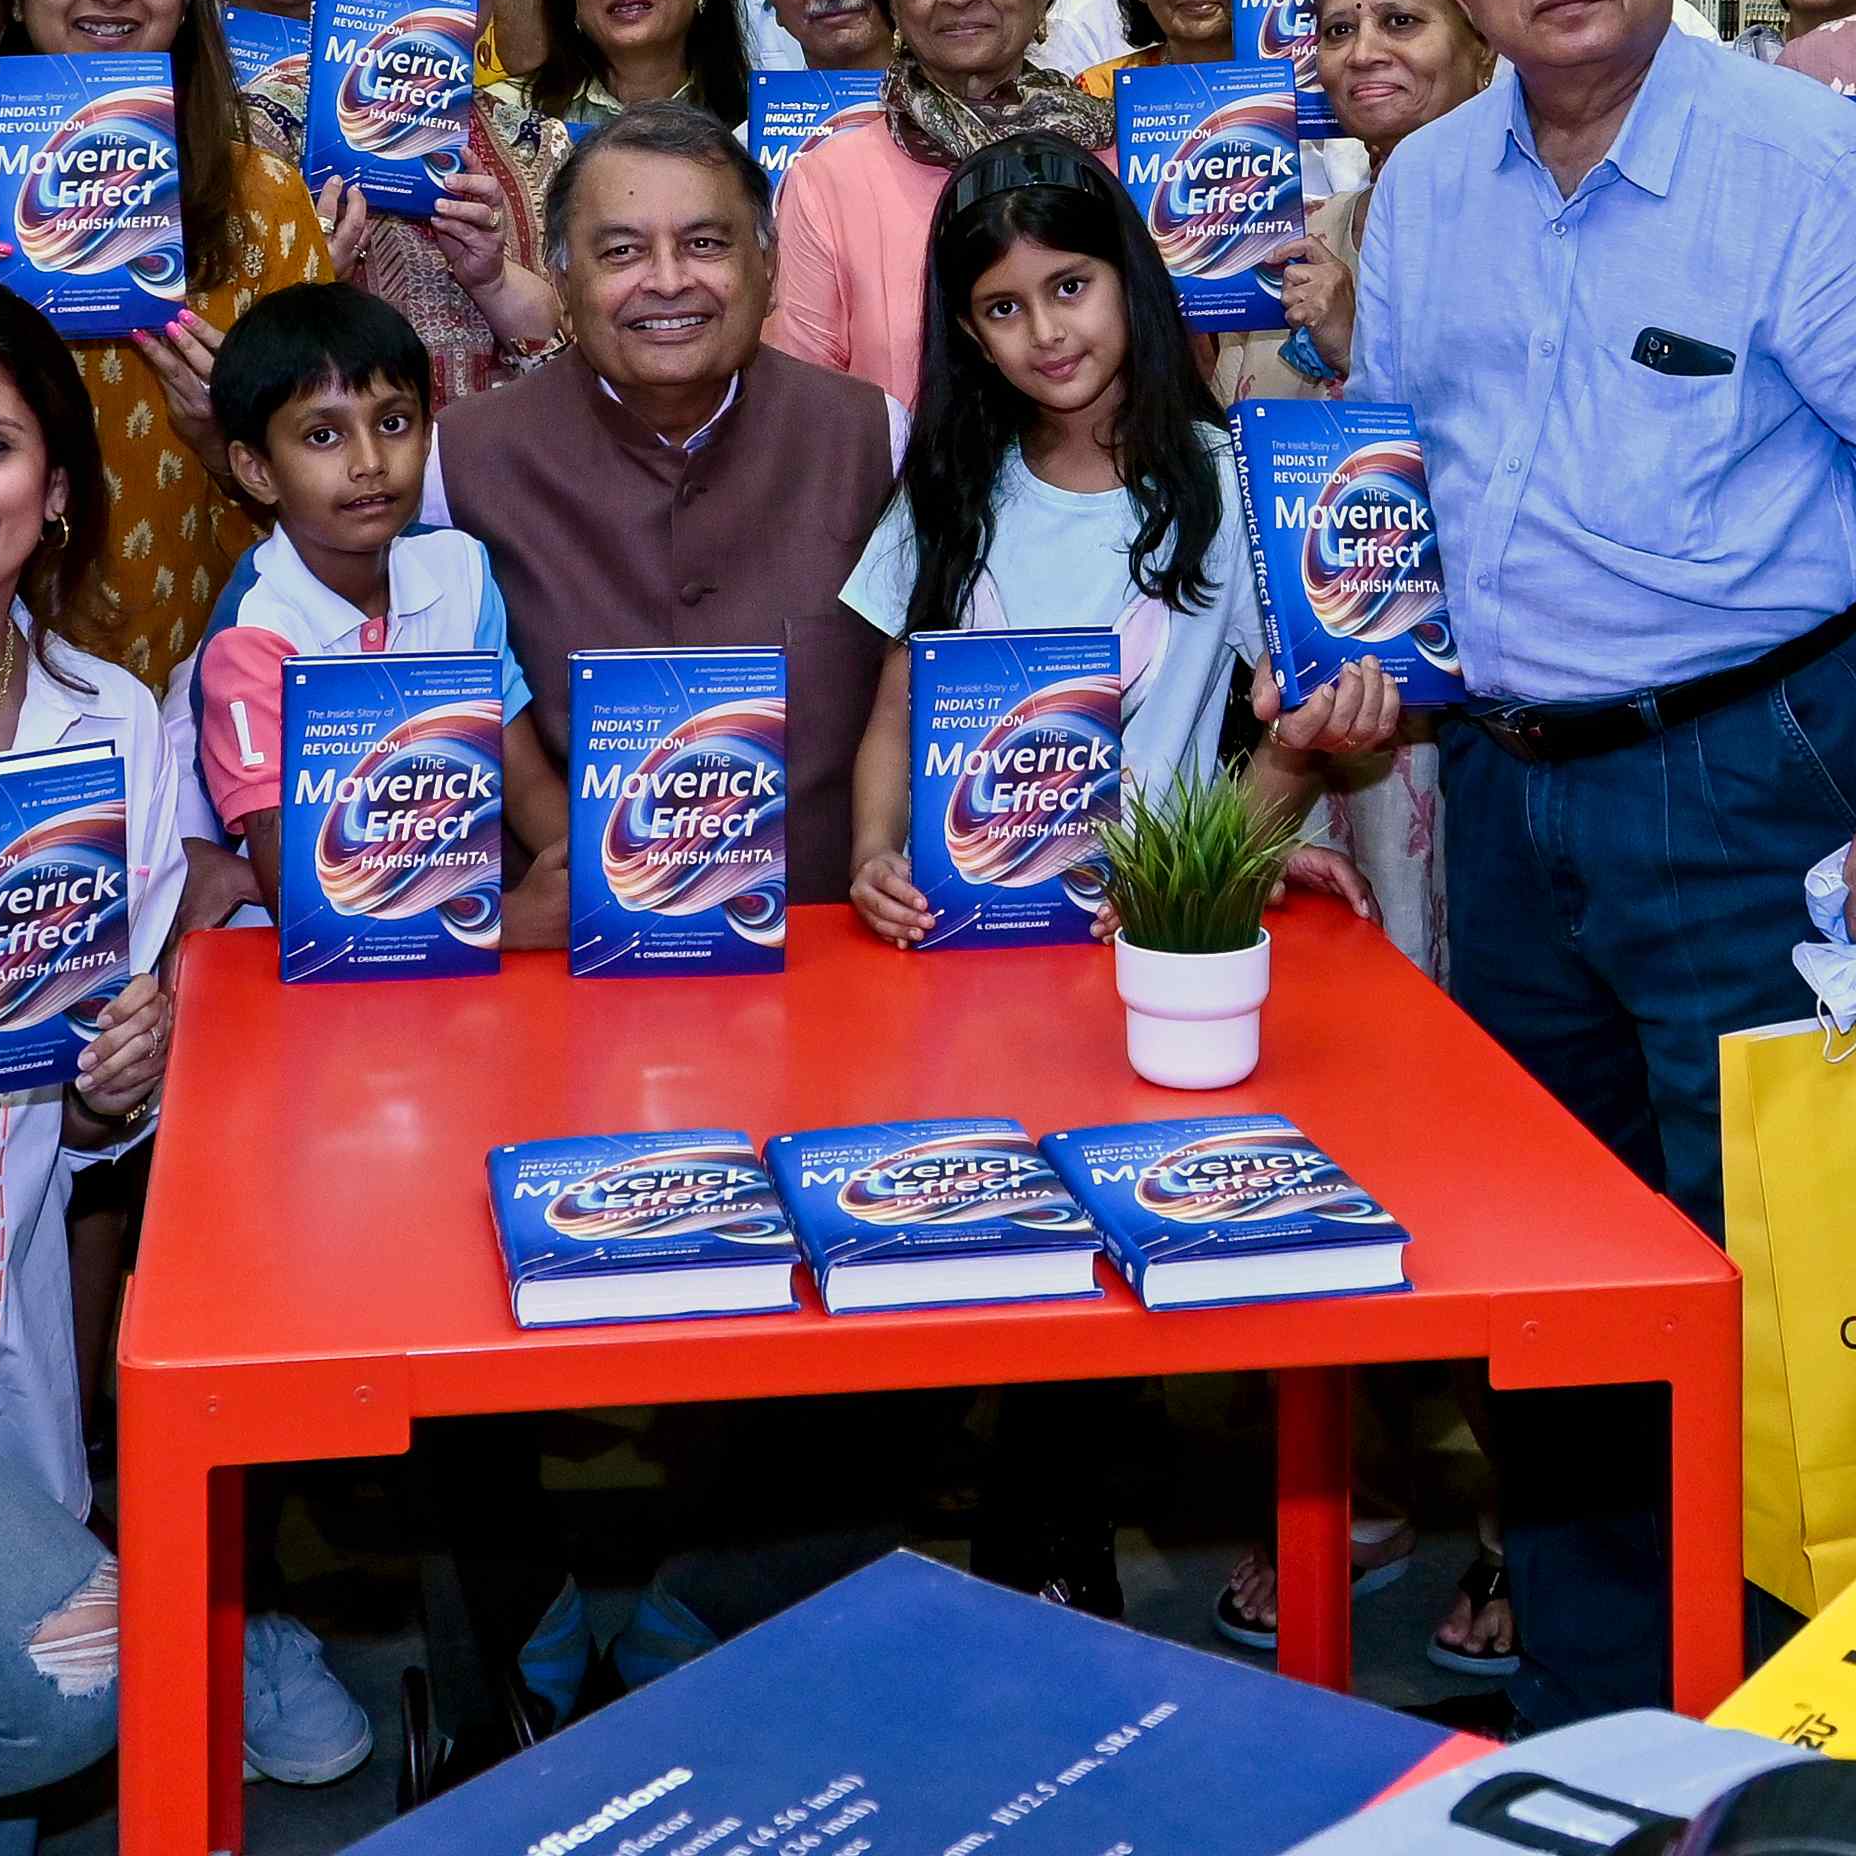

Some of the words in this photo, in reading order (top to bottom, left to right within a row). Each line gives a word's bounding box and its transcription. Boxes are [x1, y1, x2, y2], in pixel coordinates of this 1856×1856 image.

[325, 35, 470, 82] Maverick
[373, 77, 453, 110] Effect
[1128, 146, 1293, 183] Maverick
[58, 180, 155, 208] Effect
[1187, 185, 1279, 215] Effect
[56, 218, 115, 231] HARISH
[119, 215, 171, 229] MEHTA
[1229, 414, 1244, 451] The
[1236, 454, 1261, 547] Maverick
[1274, 496, 1431, 530] Maverick
[1337, 539, 1422, 568] Effect
[1251, 550, 1272, 608] Effect
[305, 724, 358, 737] INDIA'S
[361, 723, 376, 735] IT
[592, 720, 643, 732] INDIA'S
[646, 720, 661, 731] IT
[302, 741, 400, 755] REVOLUTION
[589, 738, 685, 750] REVOLUTION
[925, 737, 1114, 776] Maverick
[294, 764, 495, 804] Maverick
[581, 762, 779, 799] Maverick
[991, 781, 1095, 814] Effect
[364, 810, 475, 843] Effect
[650, 808, 759, 839] Effect
[361, 854, 427, 870] HARISH
[430, 850, 489, 867] MEHTA
[646, 851, 712, 865] HARISH
[715, 849, 773, 864] MEHTA
[55, 950, 117, 974] MEHTA
[513, 1168, 756, 1200] Maverick
[801, 1157, 1039, 1188] Maverick
[895, 1174, 1023, 1194] Effect
[1091, 1152, 1325, 1186] Maverick
[1187, 1170, 1314, 1193] Effect
[605, 1188, 737, 1209] Effect
[1094, 1724, 1143, 1756] SR4
[1139, 1701, 1180, 1730] mm
